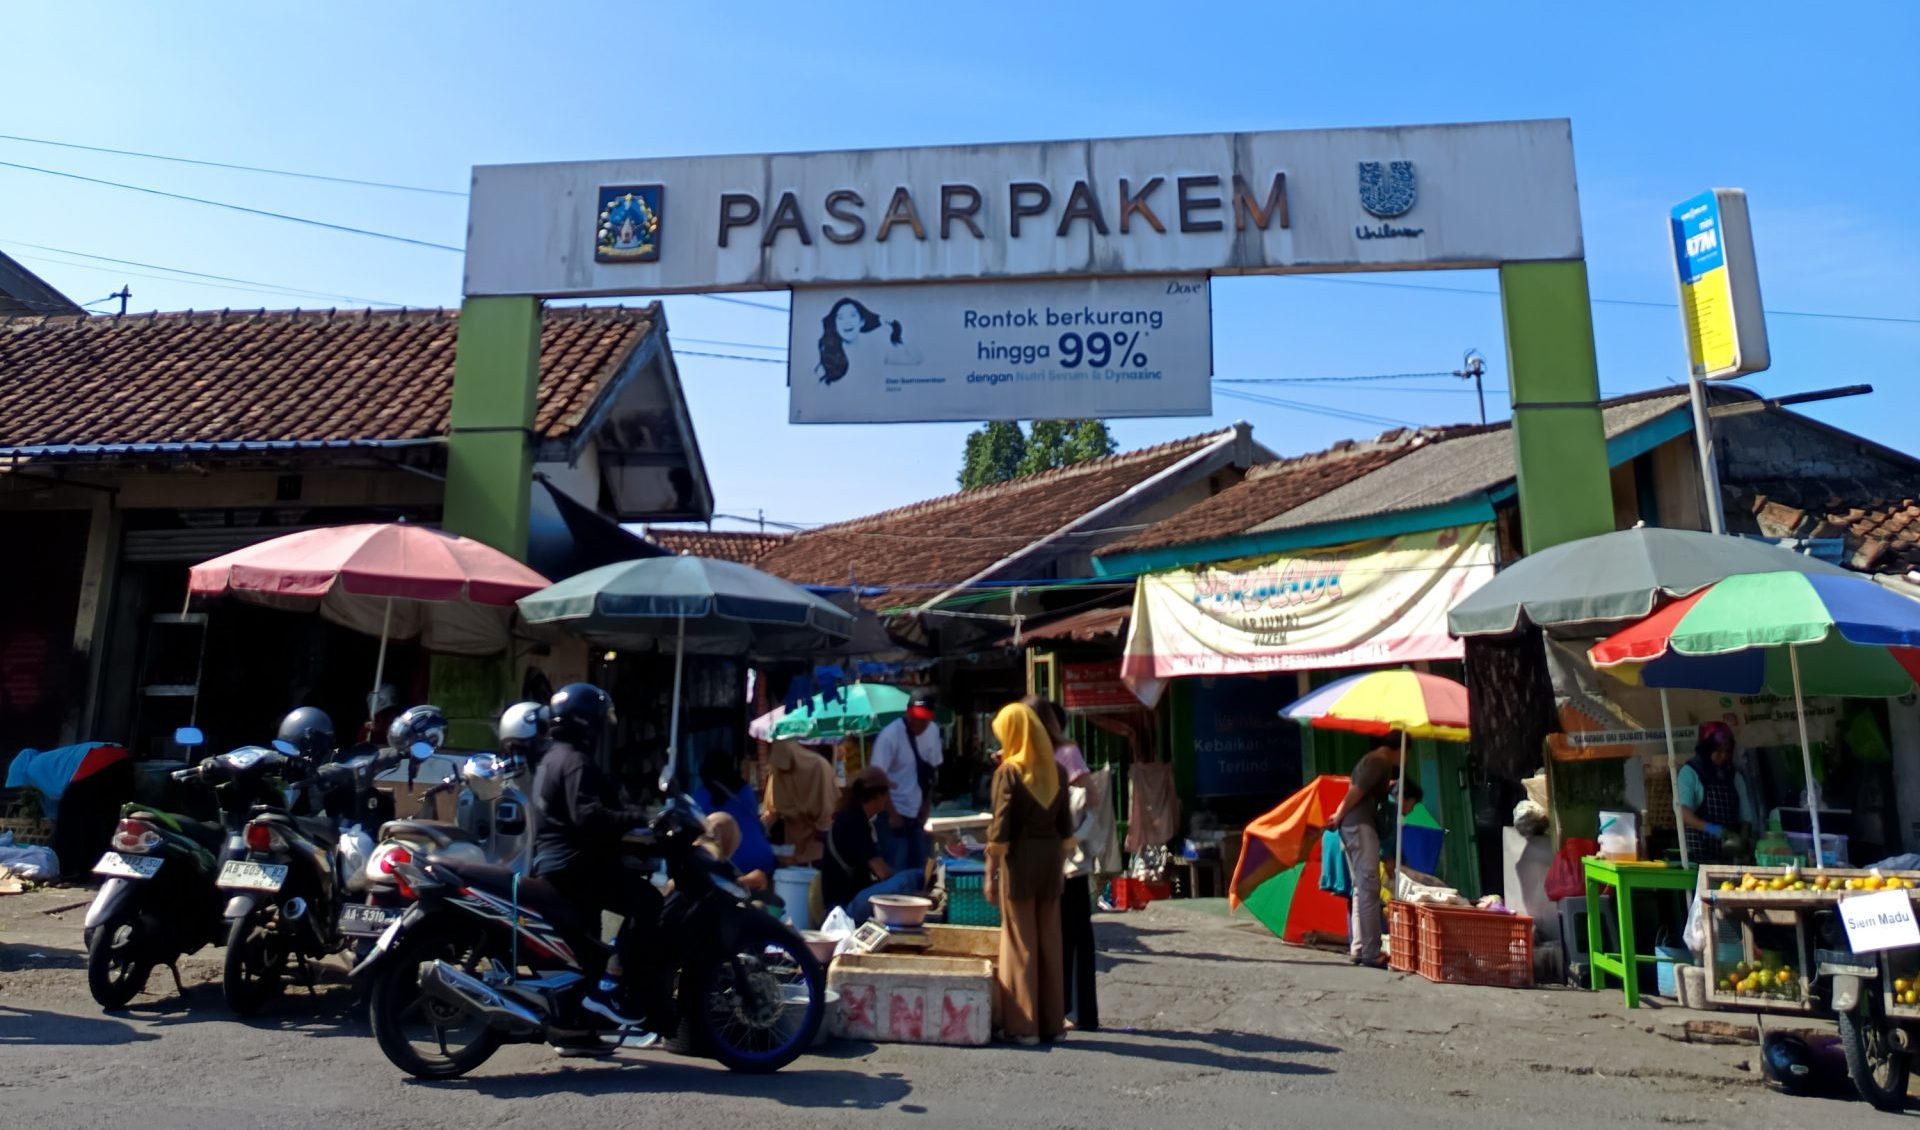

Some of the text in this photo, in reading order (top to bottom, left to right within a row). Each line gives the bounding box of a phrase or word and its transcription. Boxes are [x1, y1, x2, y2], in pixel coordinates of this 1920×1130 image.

[717, 172, 1290, 248] PASAR PAKEM
[1166, 281, 1202, 295] Dove
[964, 306, 1164, 329] Rontok berkurang
[977, 341, 1050, 364] hingga
[966, 371, 1013, 385] dengan
[1016, 369, 1046, 382] Nutri
[1048, 370, 1089, 382] Serum
[1105, 368, 1162, 382] Dynazinc
[1878, 911, 1910, 925] Madu
